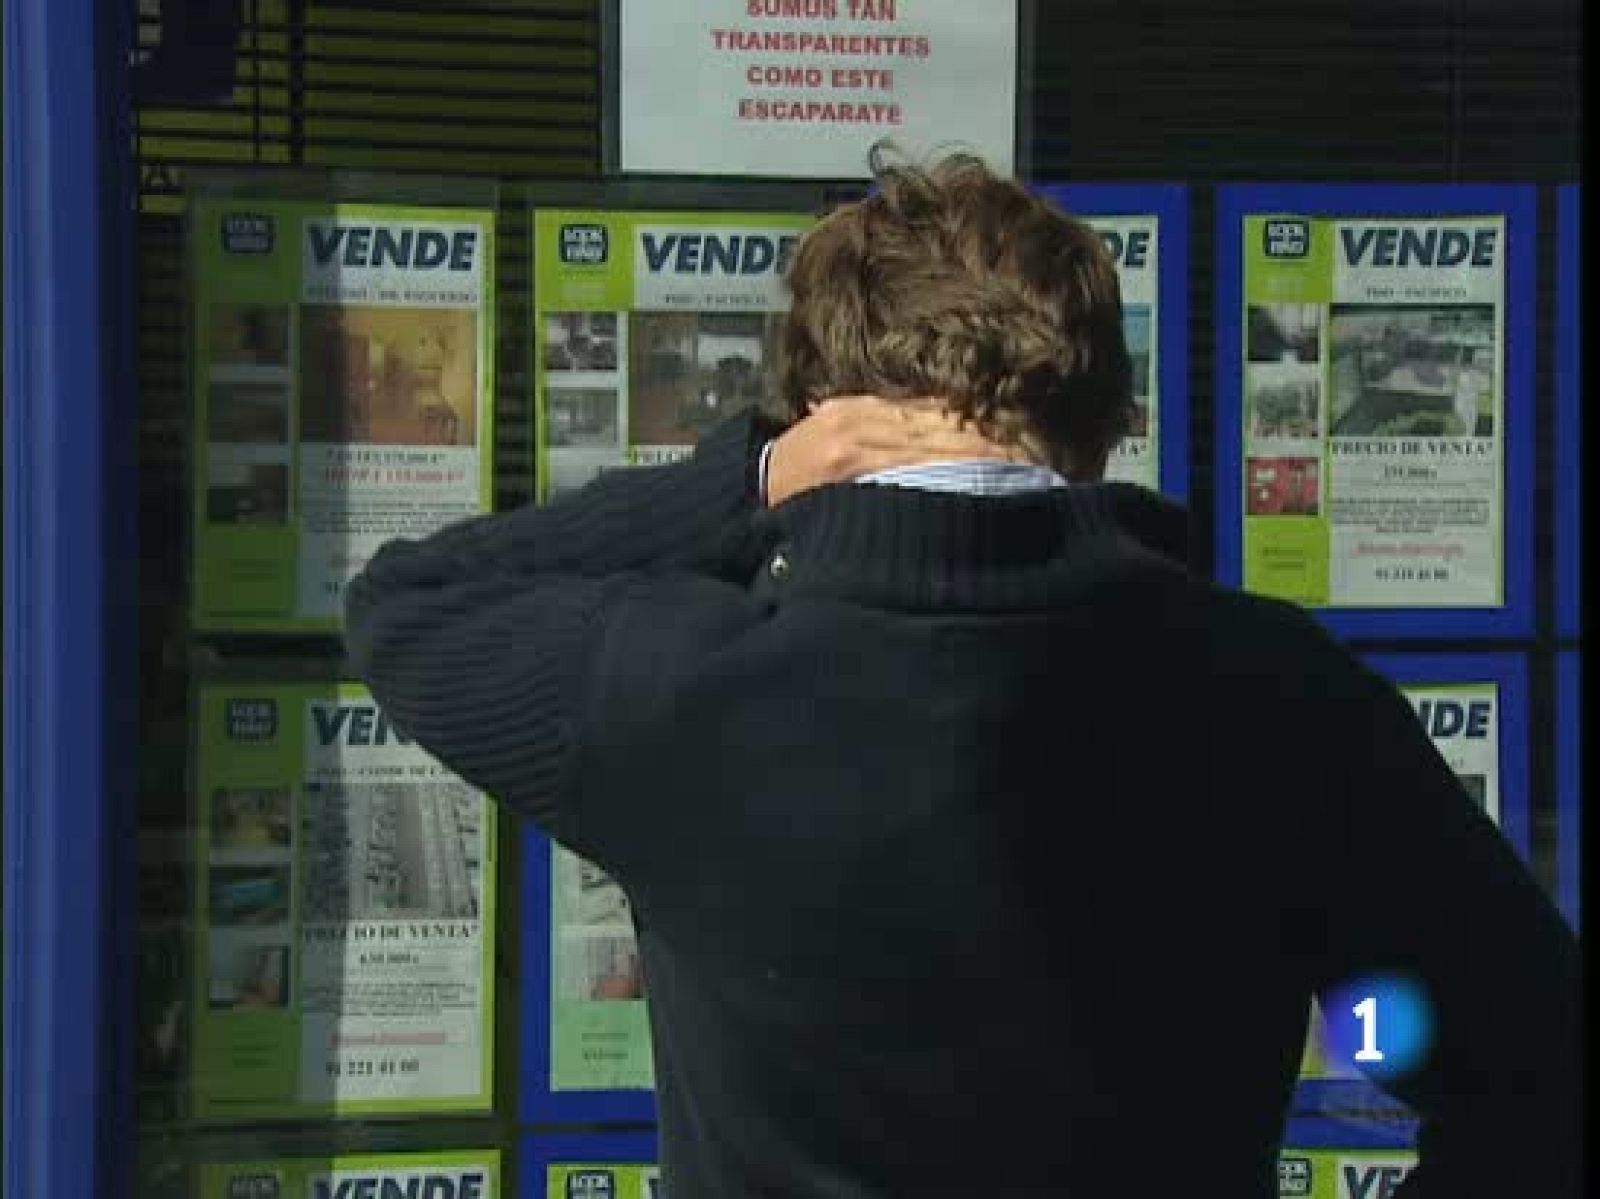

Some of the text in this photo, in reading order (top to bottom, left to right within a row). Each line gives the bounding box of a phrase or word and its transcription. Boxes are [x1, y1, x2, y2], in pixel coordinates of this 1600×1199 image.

[847, 0, 897, 21] TAN
[711, 30, 930, 58] TRANSPARENTES
[747, 66, 894, 90] COMO ESTE
[738, 99, 903, 125] ESCAPARATE
[308, 224, 478, 271] VENDE
[1341, 228, 1498, 268] VENDE
[313, 1172, 484, 1199] VENDE
